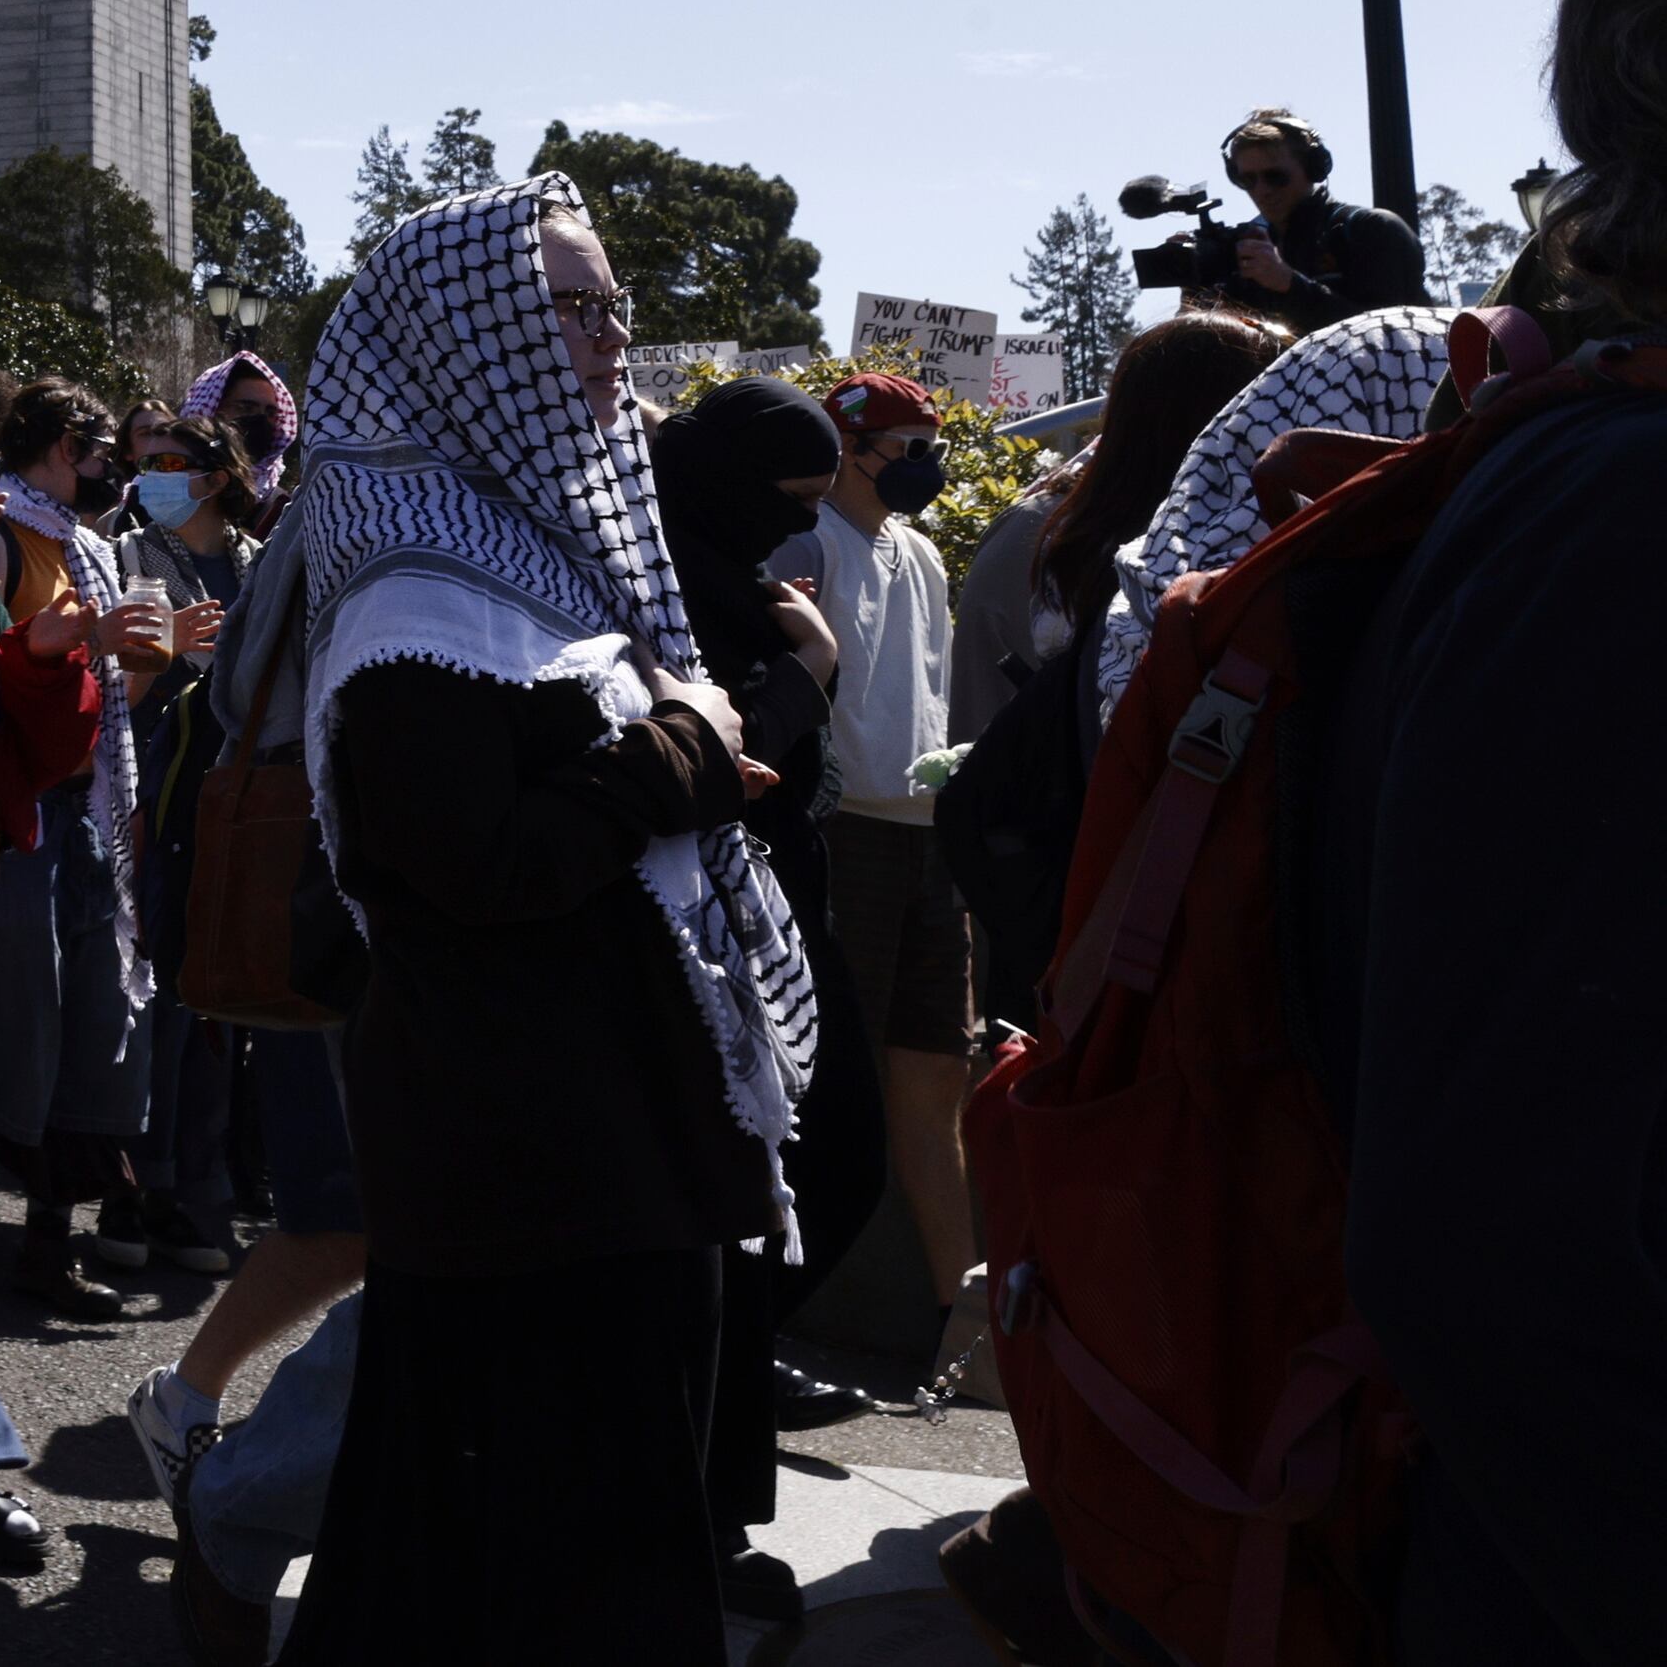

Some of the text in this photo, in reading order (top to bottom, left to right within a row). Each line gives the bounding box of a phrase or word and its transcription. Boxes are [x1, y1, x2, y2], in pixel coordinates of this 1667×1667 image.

[873, 299, 973, 327] YOU CAN'T
[858, 323, 920, 345] FIGHT
[928, 327, 994, 356] TRUMP
[760, 350, 792, 375] OUT
[653, 369, 688, 388] OU
[1036, 391, 1060, 409] ON
